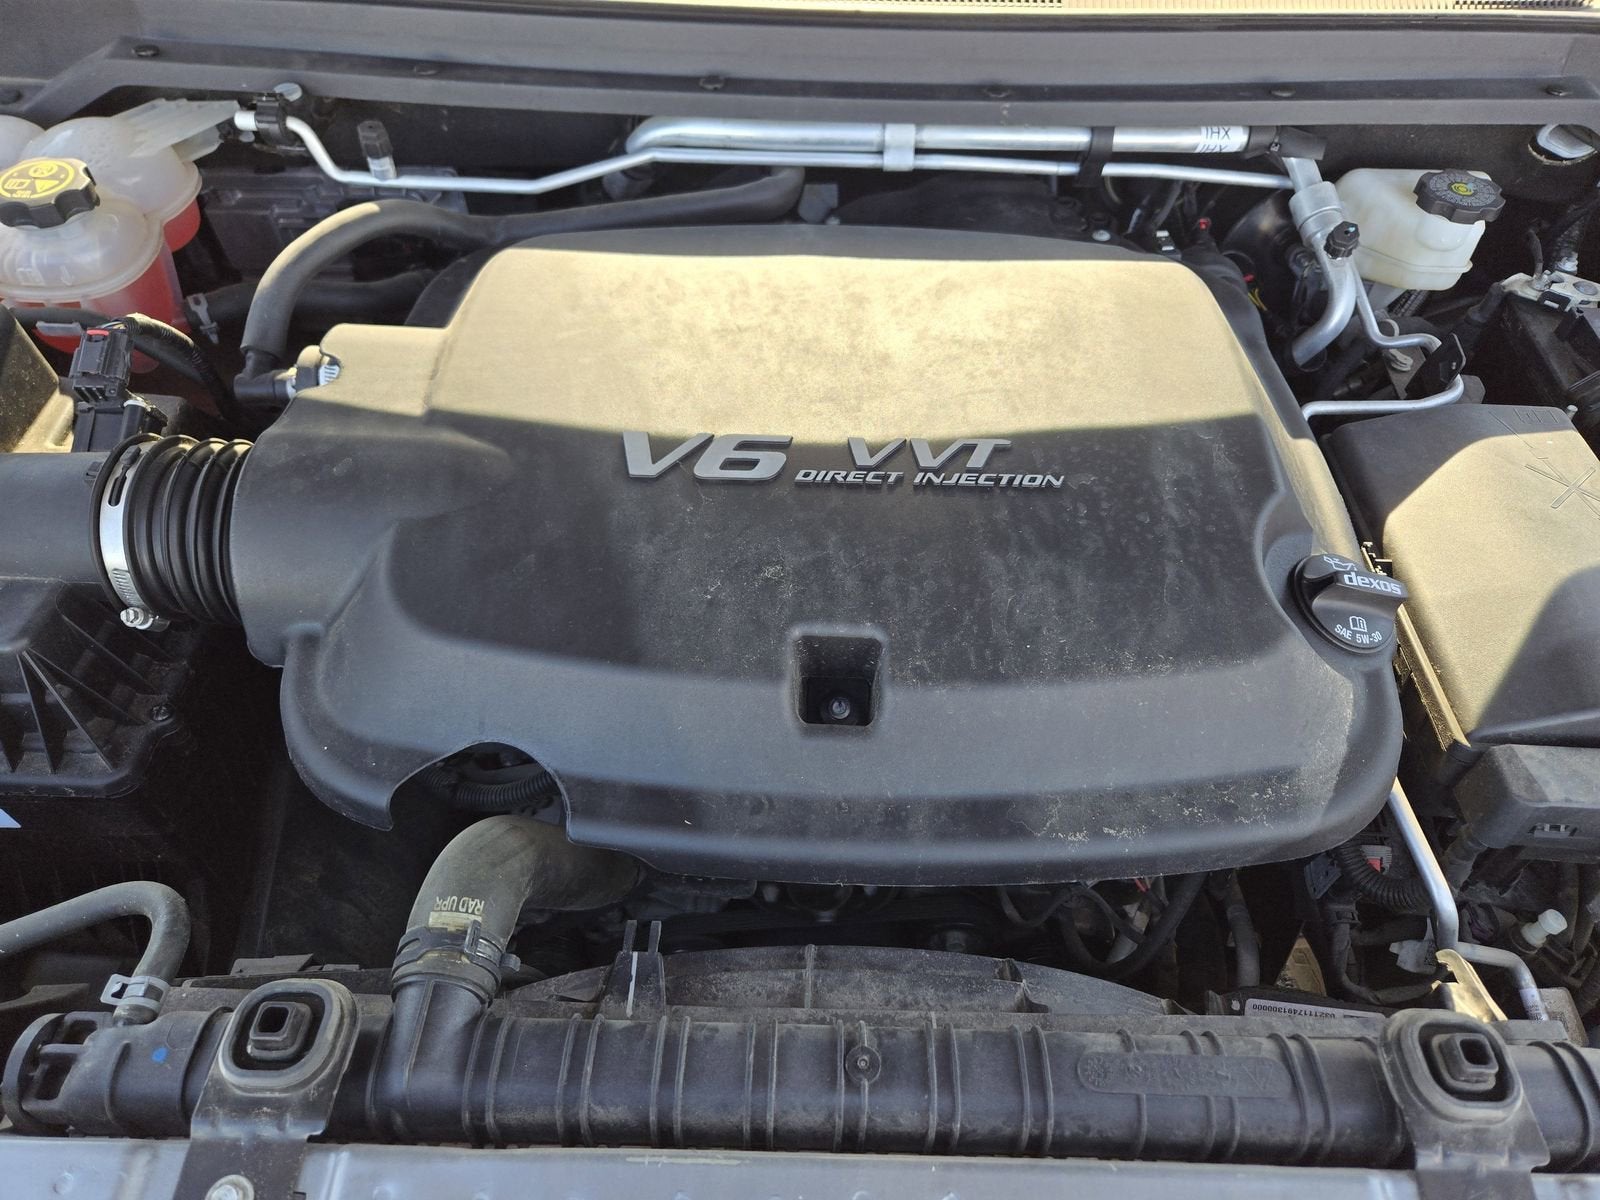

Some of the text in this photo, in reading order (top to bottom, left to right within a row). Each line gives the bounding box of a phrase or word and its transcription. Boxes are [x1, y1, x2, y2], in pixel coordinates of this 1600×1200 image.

[623, 431, 1012, 480] V6 VVT
[795, 469, 1065, 488] DIRECT INJECTION
[1344, 572, 1402, 595] dexos
[1335, 624, 1383, 644] SAE 5W-30
[434, 896, 485, 915] RAD UPR
